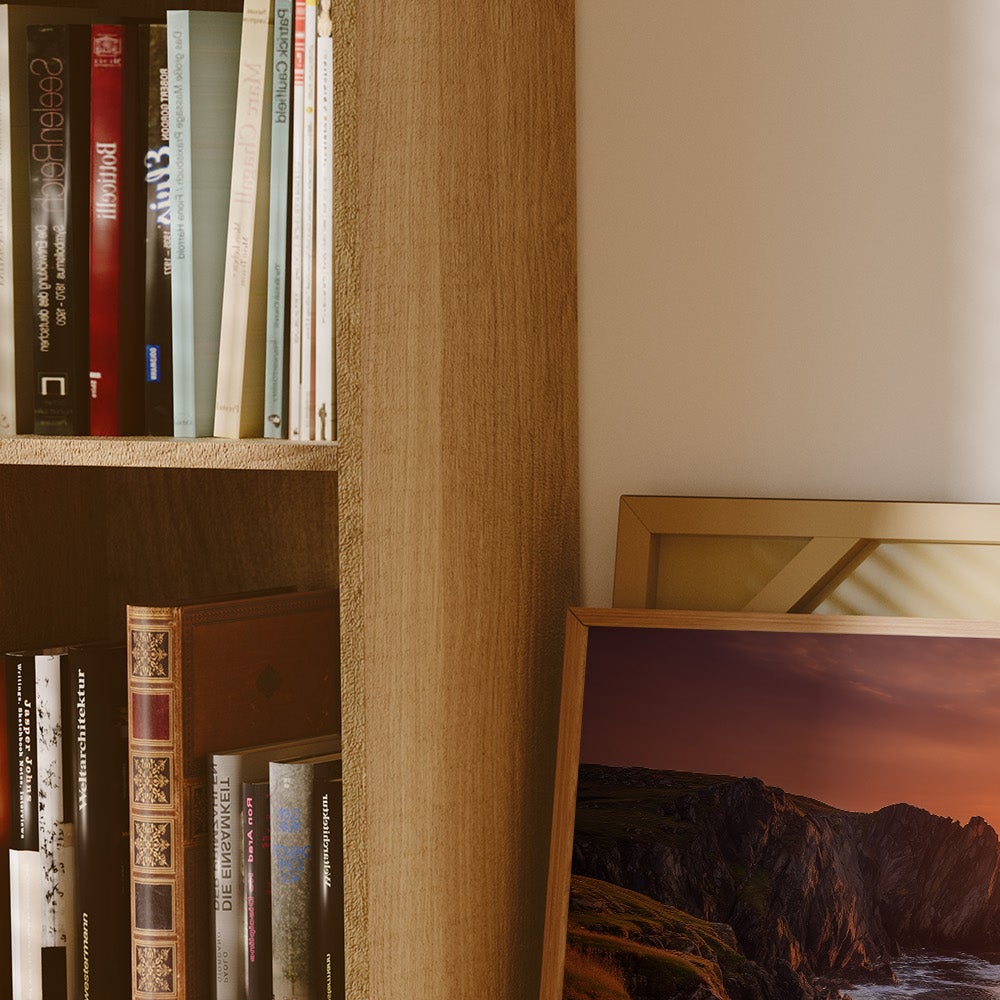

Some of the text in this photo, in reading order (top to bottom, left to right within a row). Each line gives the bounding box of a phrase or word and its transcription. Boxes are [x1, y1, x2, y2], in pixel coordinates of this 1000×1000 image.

[23, 699, 33, 803] Jasper Johns
[77, 668, 87, 812] Weltarchitektur
